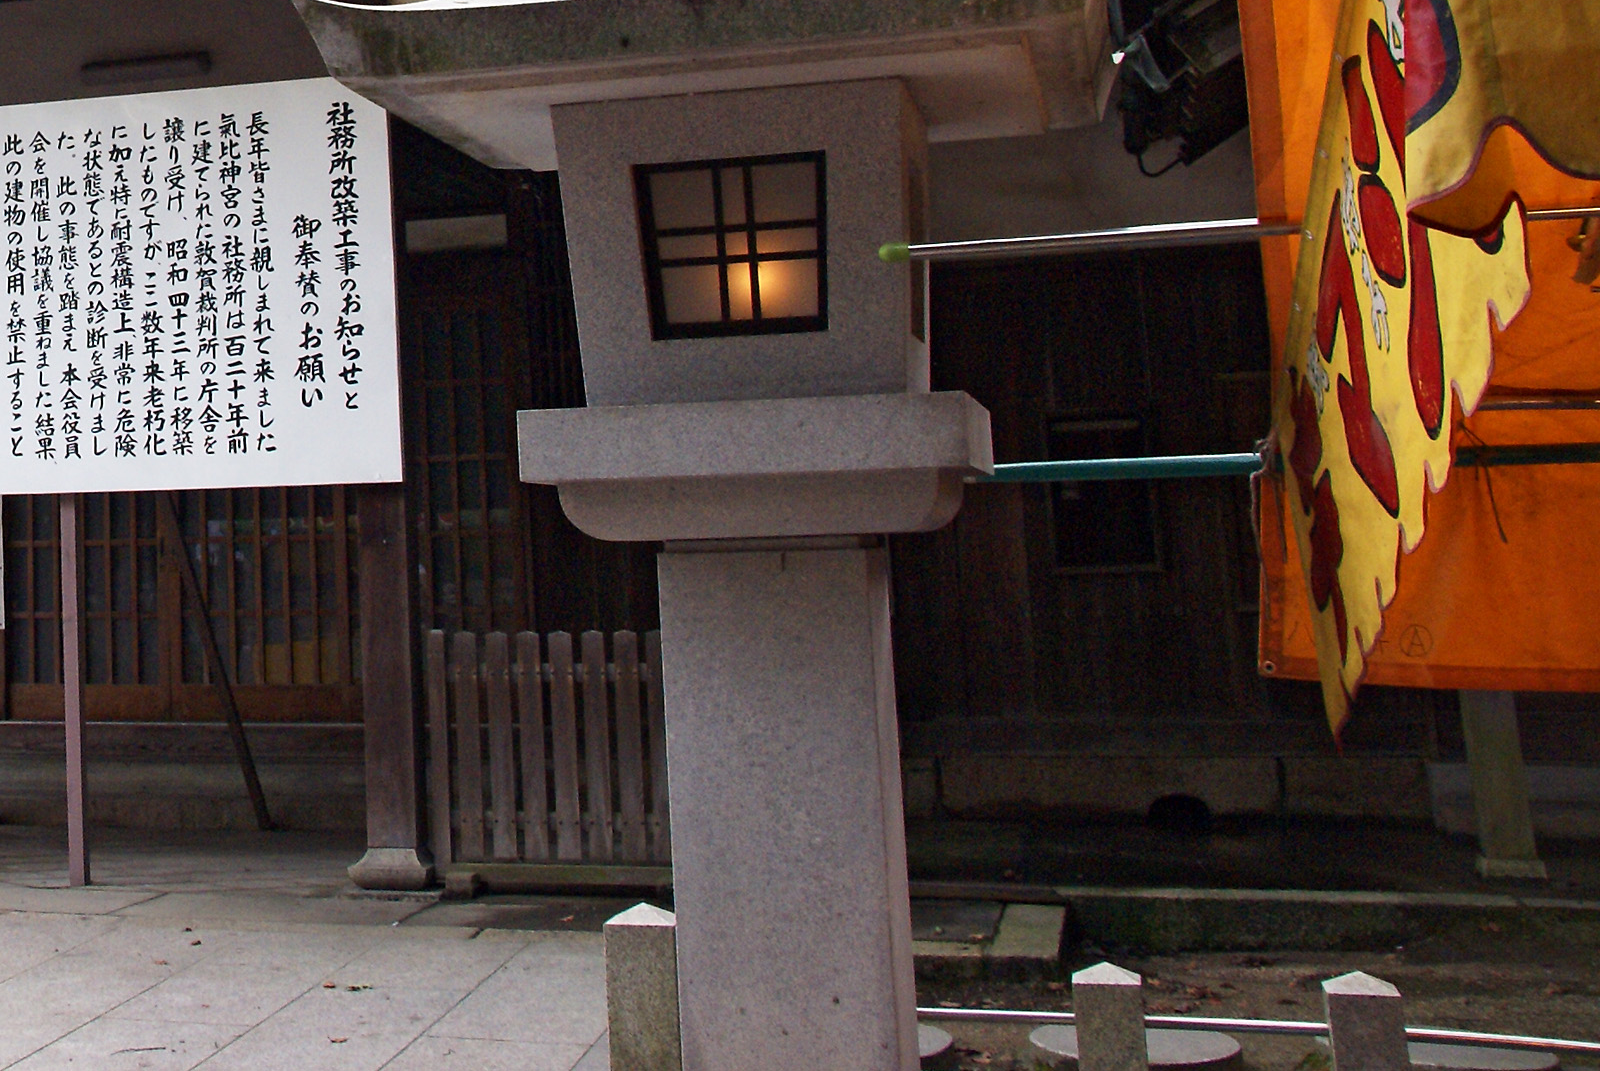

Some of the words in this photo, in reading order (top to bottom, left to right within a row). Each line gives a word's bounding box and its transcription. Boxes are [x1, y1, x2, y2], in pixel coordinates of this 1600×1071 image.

[2, 133, 27, 457] 此の建物の使用を禁止すること
[81, 128, 109, 456] な状態であるとの診断を受けまし
[190, 120, 223, 455] に建てられた敦賀裁判所の庁舎を
[245, 110, 277, 452] 長年皆さまに親しまれて来ました
[291, 213, 326, 408] 御奉賛のお願い
[325, 101, 365, 410] 社務所改築工事のお知らせと
